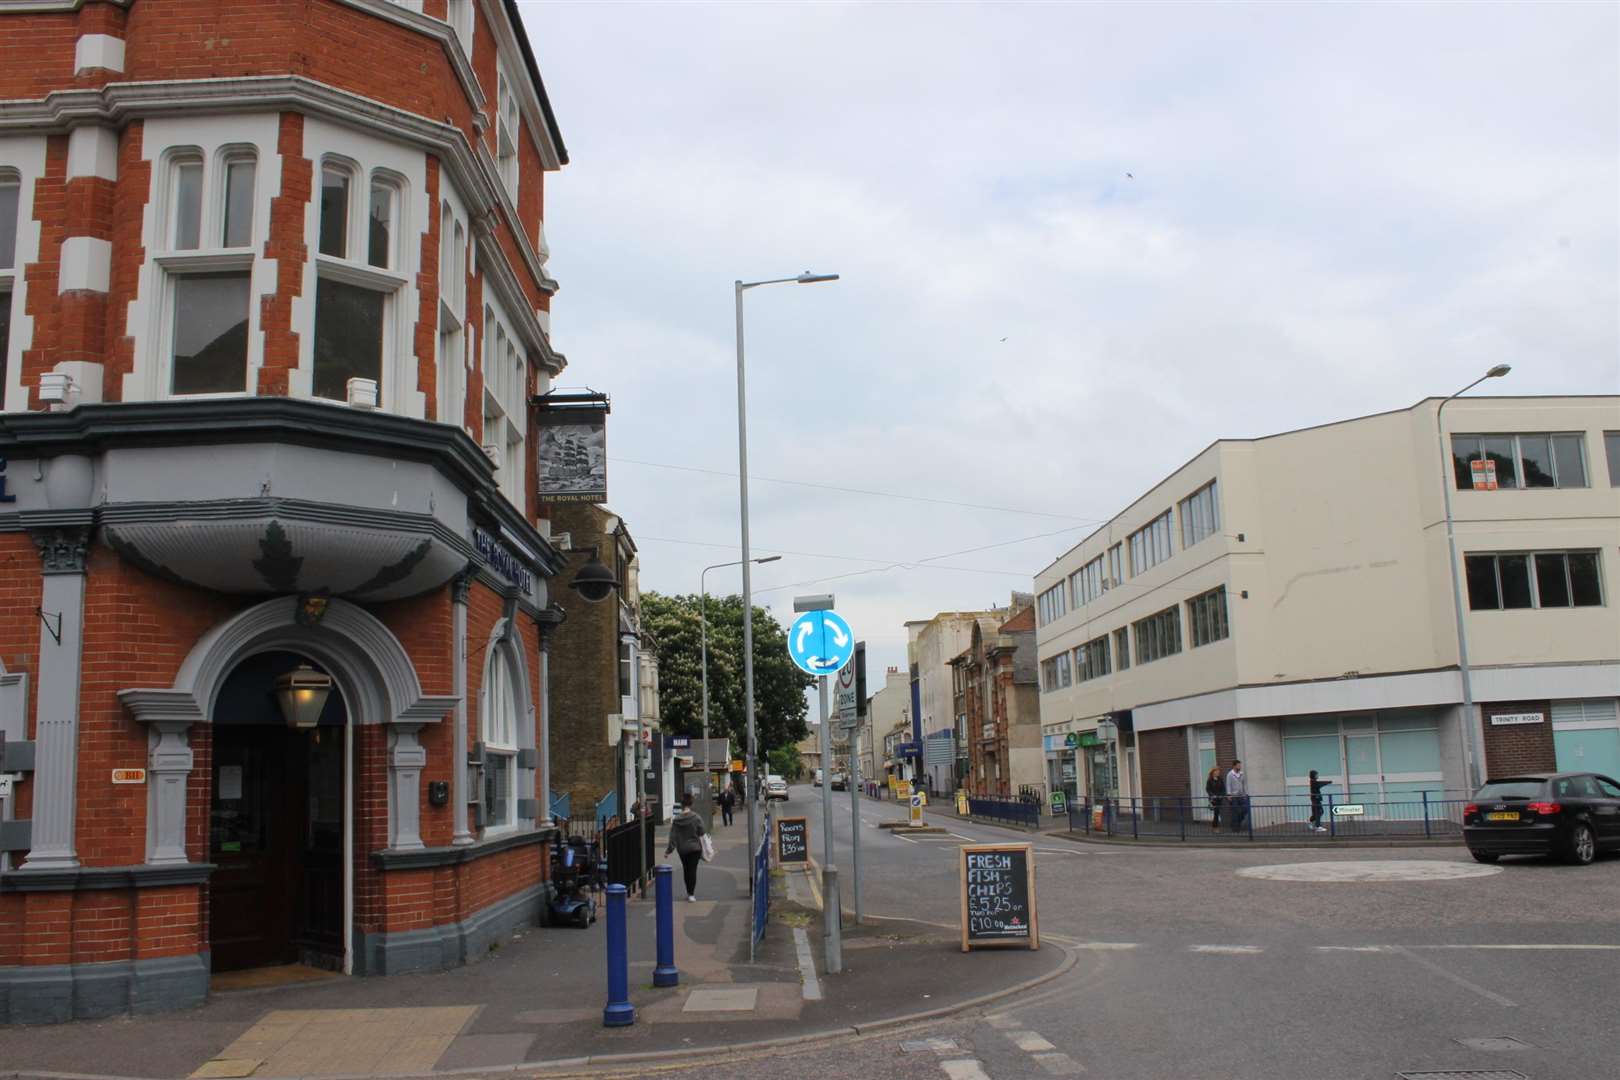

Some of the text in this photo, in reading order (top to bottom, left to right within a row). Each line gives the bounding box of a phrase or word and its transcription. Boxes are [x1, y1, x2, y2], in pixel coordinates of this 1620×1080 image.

[840, 692, 855, 705] ZONE
[968, 855, 1011, 869] FRESH
[968, 870, 1000, 882] FISH
[968, 882, 1012, 897] CHIPS
